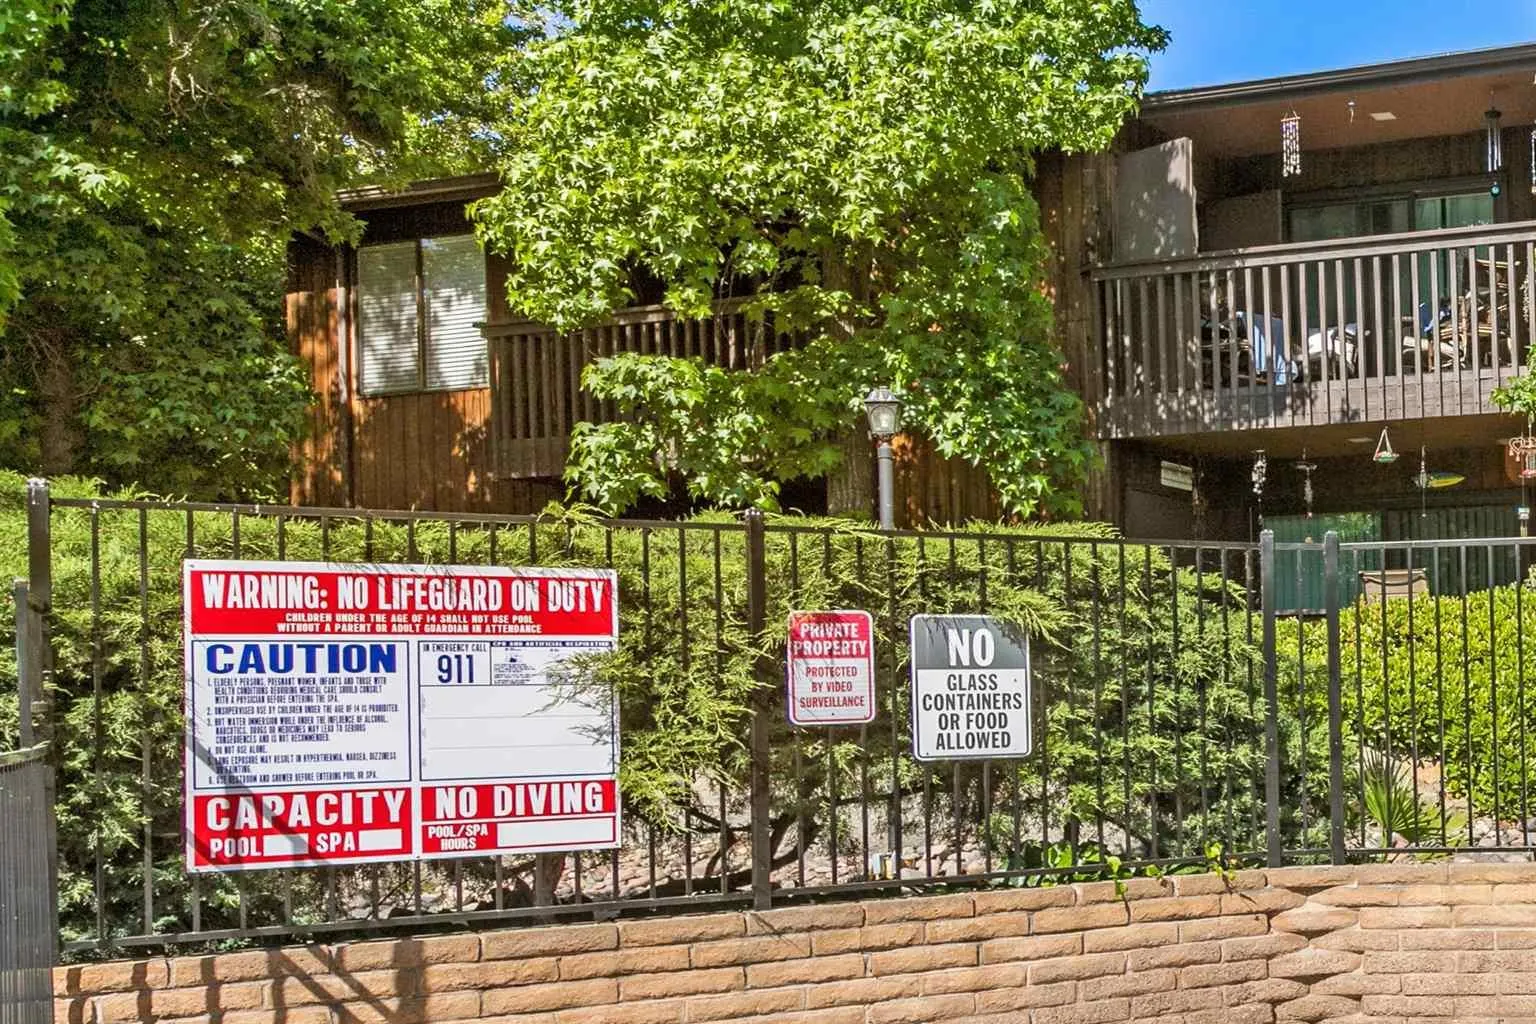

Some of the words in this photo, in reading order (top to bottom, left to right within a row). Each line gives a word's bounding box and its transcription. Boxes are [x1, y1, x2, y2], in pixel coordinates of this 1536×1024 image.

[201, 573, 329, 610] WARNING:
[337, 576, 369, 611] NO
[377, 577, 503, 613] LIFEGUARD
[511, 579, 540, 613] ON
[547, 580, 605, 613] DUTY
[286, 613, 333, 623] CHILDREN
[336, 613, 366, 623] UNDER
[370, 614, 387, 623] THE
[391, 614, 409, 624] AGE
[412, 614, 423, 624] OF
[426, 614, 437, 624] 14
[440, 614, 468, 624] SHALL
[472, 614, 489, 624] NOT
[493, 614, 510, 624] USE
[513, 614, 535, 624] POOL
[278, 623, 321, 633] WITHOUT
[335, 623, 372, 633] PARENT
[376, 624, 388, 633] OR
[392, 624, 420, 633] ADULT
[424, 624, 470, 634] GUARDIAN
[472, 624, 483, 634] IN
[485, 624, 543, 634] ATTENDANCE
[799, 622, 859, 639] PRIVATE
[432, 643, 469, 653] EMERGENCY
[472, 643, 488, 653] CALL
[793, 640, 867, 657] PROPERTY
[948, 627, 995, 667] NO
[206, 643, 397, 675] CAUTION
[438, 654, 475, 684] 911
[805, 665, 858, 678] PROTECTED
[811, 681, 823, 693] BY
[827, 680, 853, 692] VIDEO
[947, 673, 998, 692] GLASS
[799, 695, 865, 709] SURVEILLANCE
[922, 692, 1022, 712] CONTAINERS
[938, 712, 961, 731] OR
[966, 712, 1008, 730] FOOD
[935, 731, 1011, 751] ALLOWED
[434, 786, 478, 820] NO
[494, 781, 604, 818] DIVING
[207, 790, 406, 831] CAPACITY
[428, 823, 488, 839] POOL/SPA
[210, 834, 263, 859] POOL
[316, 832, 356, 854] SPA
[440, 837, 477, 851] HOURS
